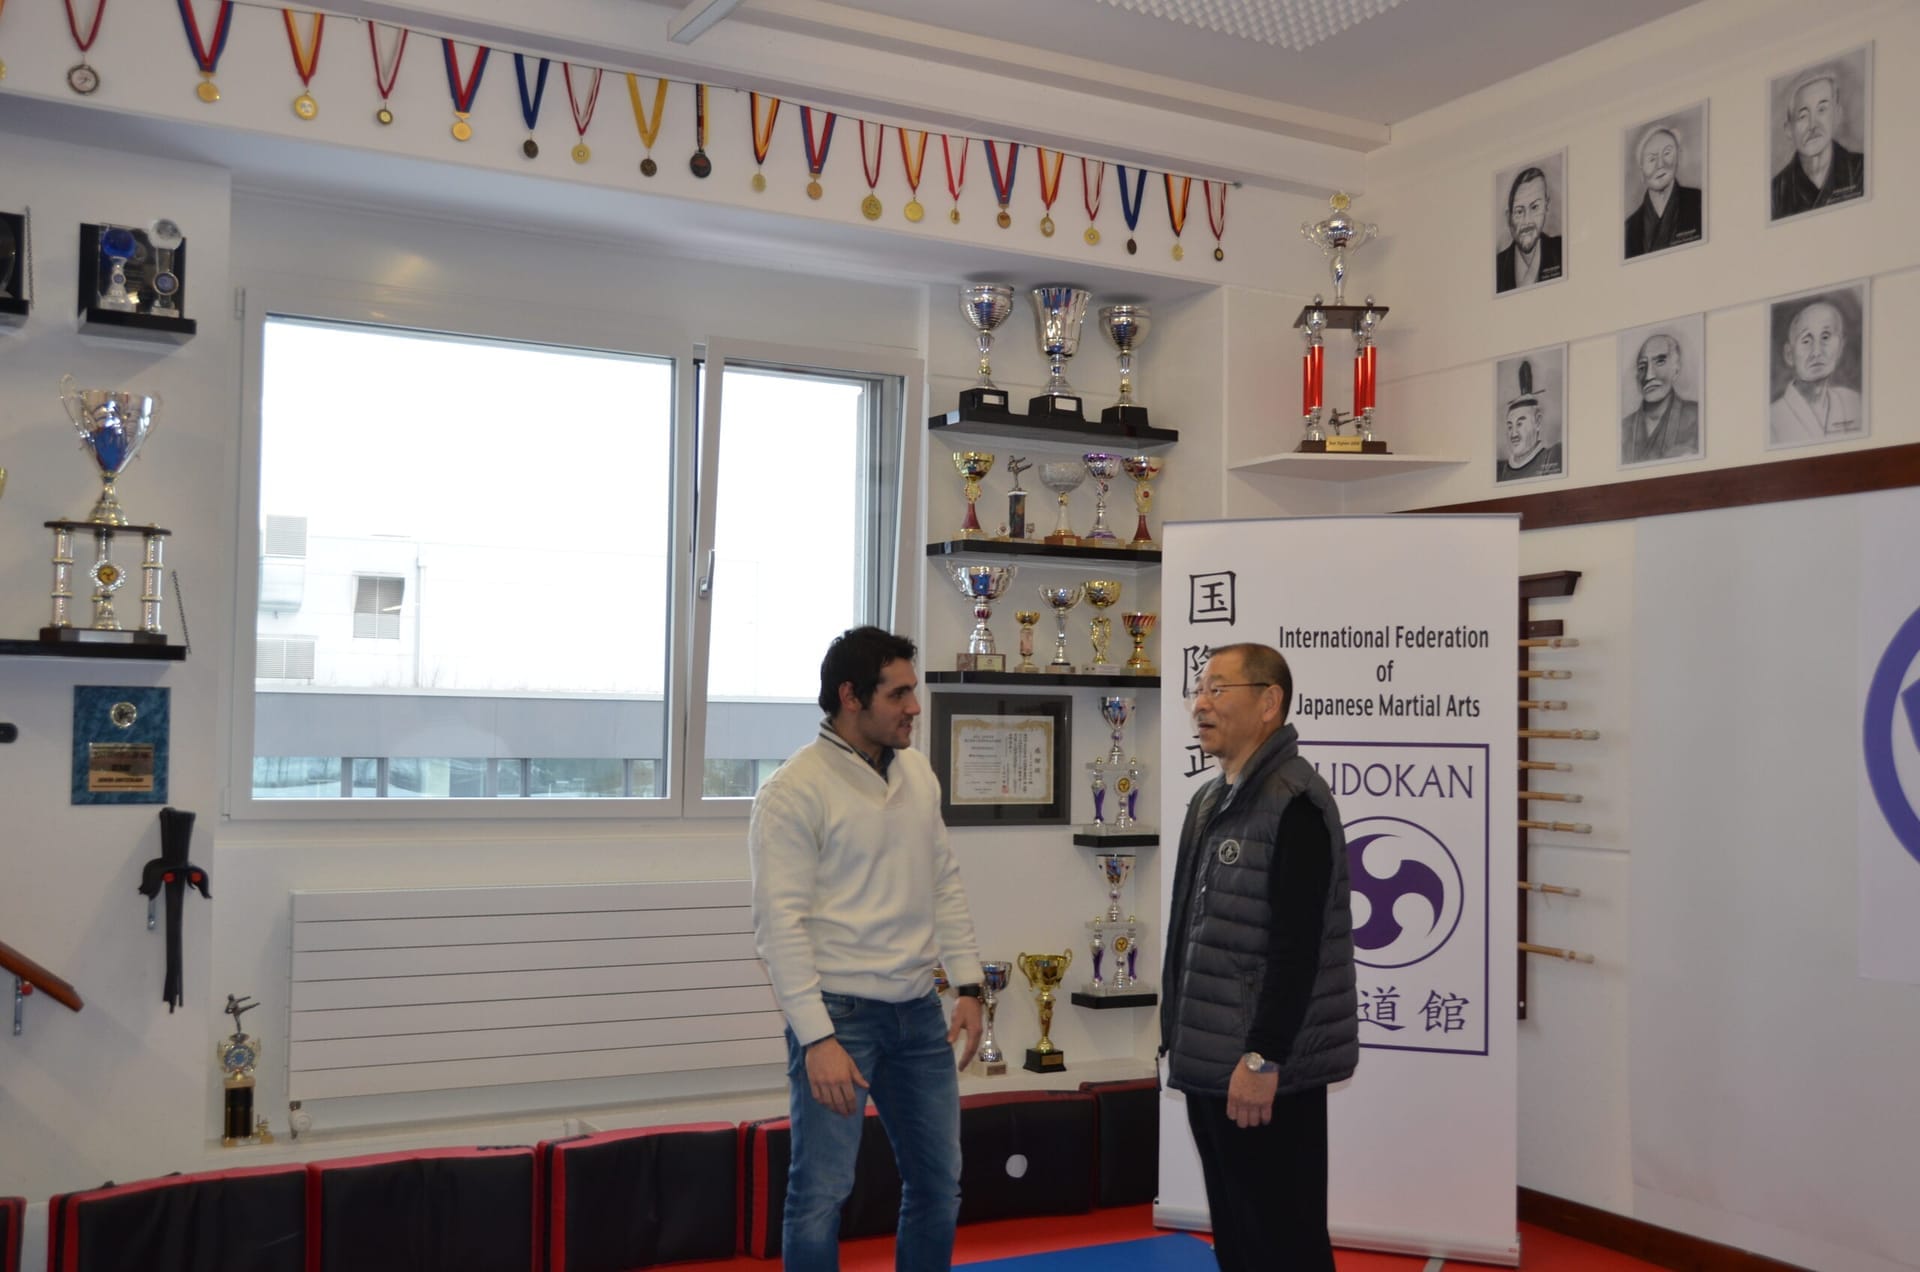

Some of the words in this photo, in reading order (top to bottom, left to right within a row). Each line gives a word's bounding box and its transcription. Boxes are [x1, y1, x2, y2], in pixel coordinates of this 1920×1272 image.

[1279, 626, 1390, 649] International
[1395, 625, 1489, 649] Federation
[1376, 660, 1394, 682] of
[1296, 693, 1374, 720] Japanese
[1379, 694, 1441, 717] Martial
[1446, 694, 1480, 717] Arts
[1315, 762, 1473, 799] UDOKAN
[1357, 985, 1470, 1034] 道館
